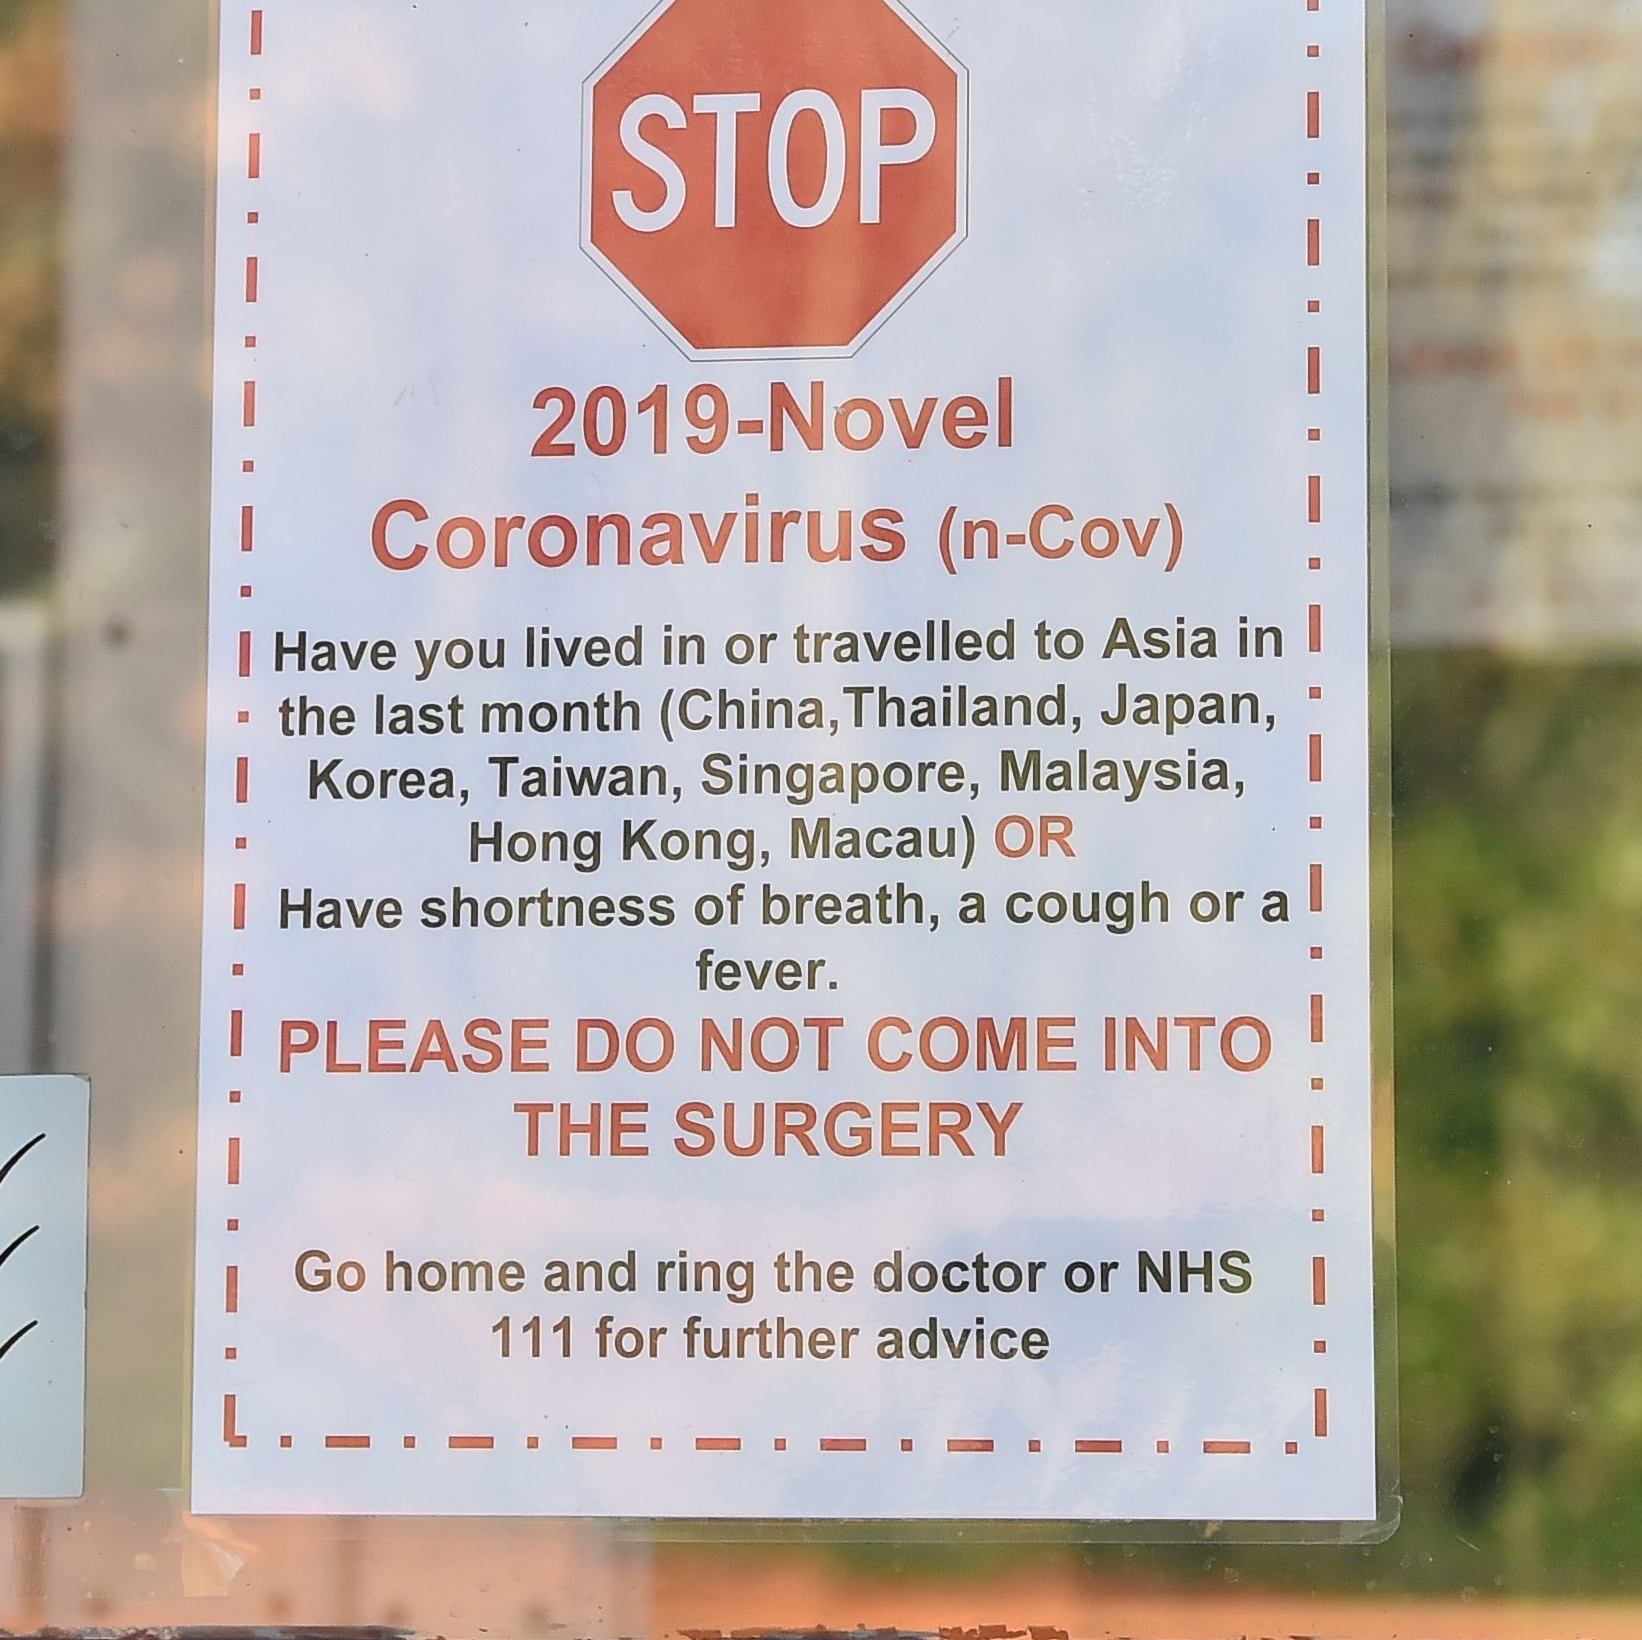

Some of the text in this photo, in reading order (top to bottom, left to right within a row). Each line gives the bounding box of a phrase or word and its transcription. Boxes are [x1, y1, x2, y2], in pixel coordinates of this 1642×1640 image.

[612, 88, 937, 232] STOP
[530, 375, 1013, 458] 2019-Novel
[371, 492, 1184, 575] Coronavirus (n-Cov)
[274, 615, 1284, 682] Have you lived in or travelled to Asia in
[278, 682, 1277, 744] the last month (China,Thailand, Japan,
[308, 746, 1247, 807] Korea, Taiwan, Singapore, Malaysia,
[469, 813, 1077, 874] Hong Kong, Macau) OR
[278, 880, 1292, 936] Have shortness of breath, a cough or a
[695, 947, 840, 992] fever.
[279, 1014, 1274, 1074] PLEASE DO NOT COME INTO
[512, 1100, 1025, 1159] THE SURGERY
[292, 1246, 1255, 1305] Go home and ring the doctor or NHS
[490, 1314, 1052, 1362] 111 for further advice
